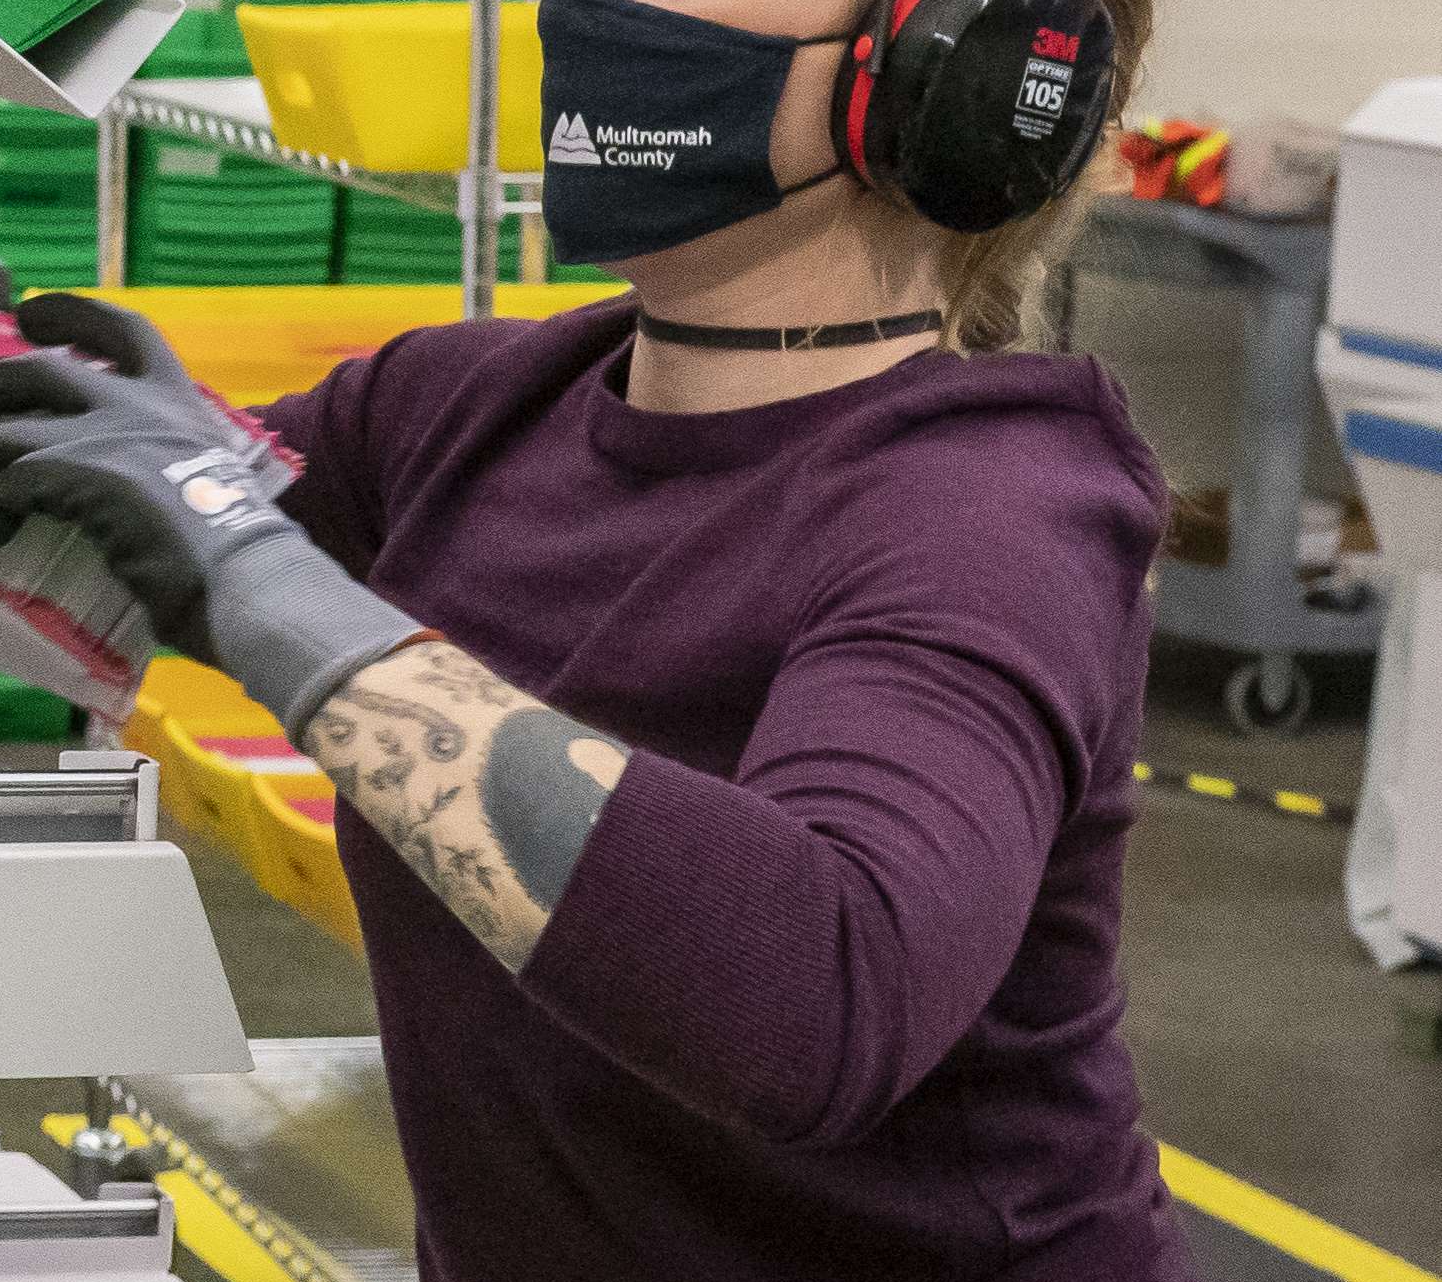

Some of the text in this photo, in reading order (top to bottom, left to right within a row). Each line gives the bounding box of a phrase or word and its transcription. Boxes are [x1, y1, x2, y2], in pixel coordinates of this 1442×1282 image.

[1032, 28, 1080, 63] 3M
[1024, 79, 1065, 111] 105
[596, 124, 713, 146] Multnomah
[604, 147, 676, 171] County
